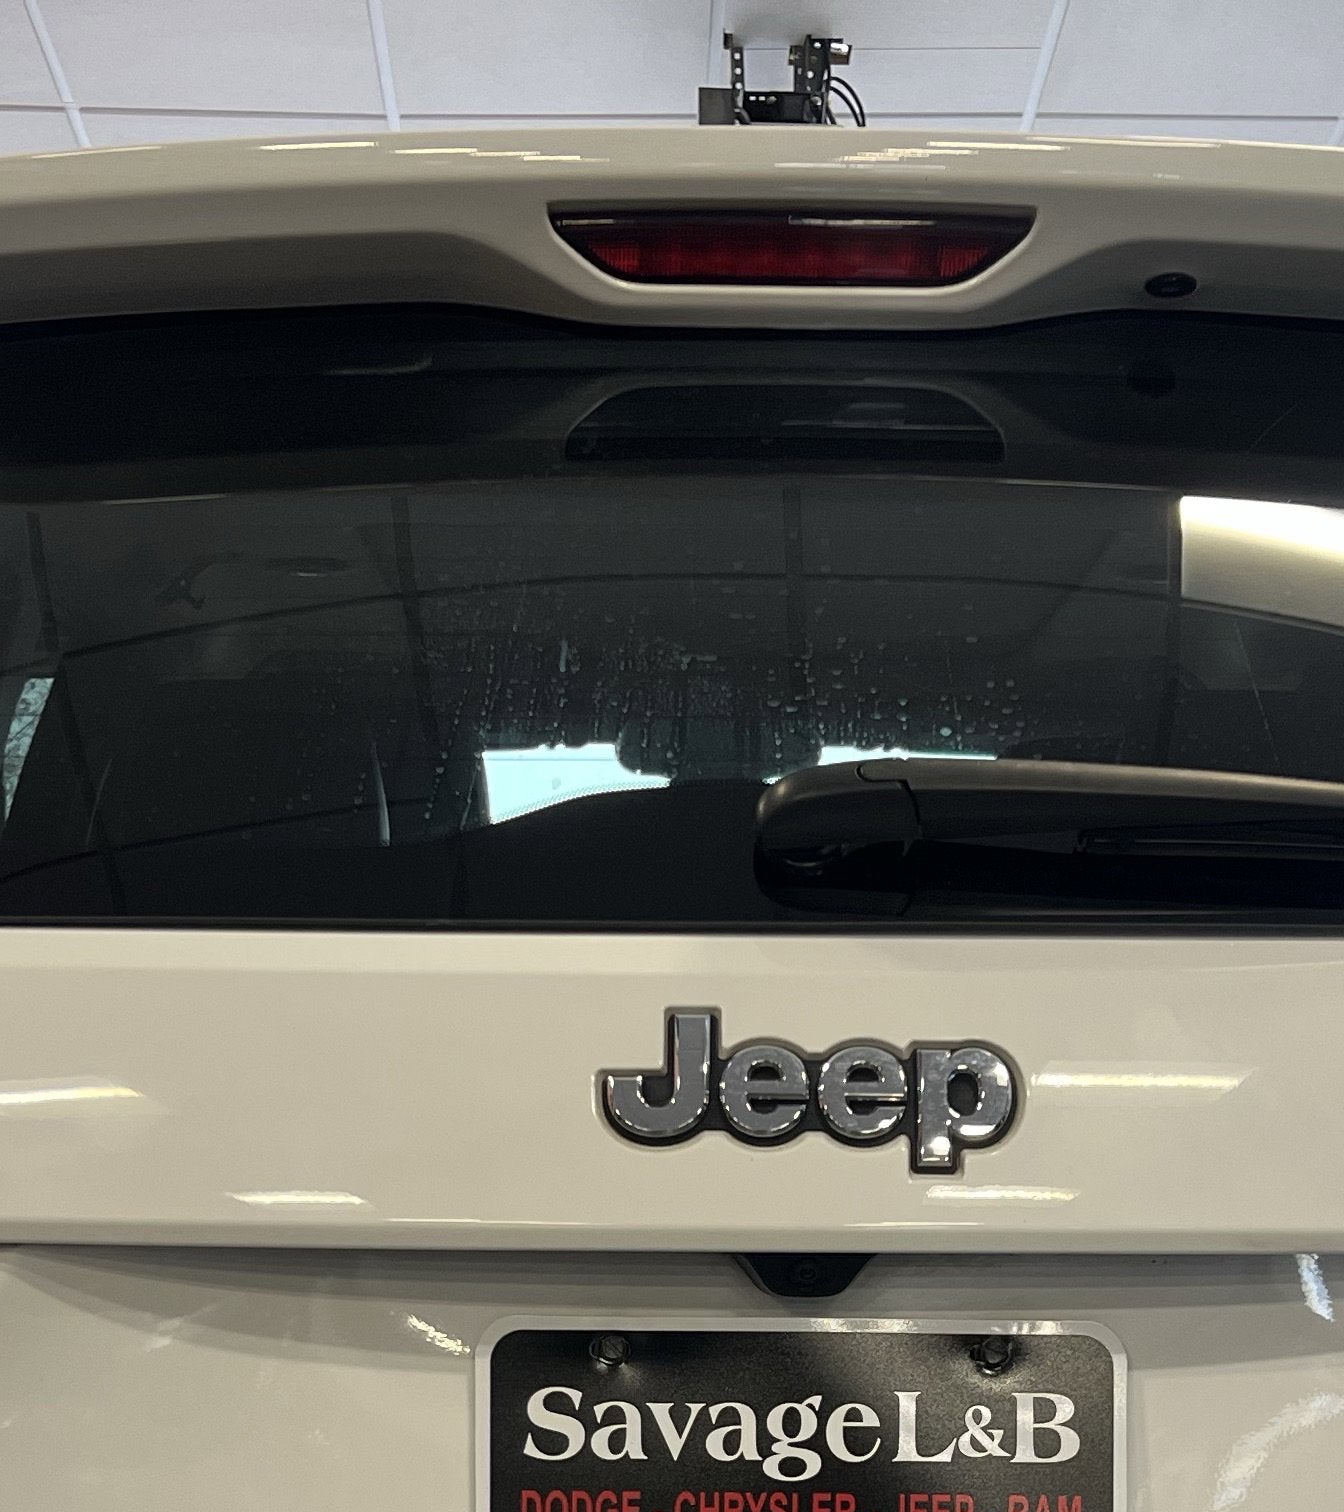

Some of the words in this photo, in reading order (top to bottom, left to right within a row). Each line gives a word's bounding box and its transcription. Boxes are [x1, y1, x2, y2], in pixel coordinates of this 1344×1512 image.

[601, 1007, 1019, 1173] Jeep
[522, 1386, 881, 1482] Savage
[892, 1391, 1081, 1463] L&B
